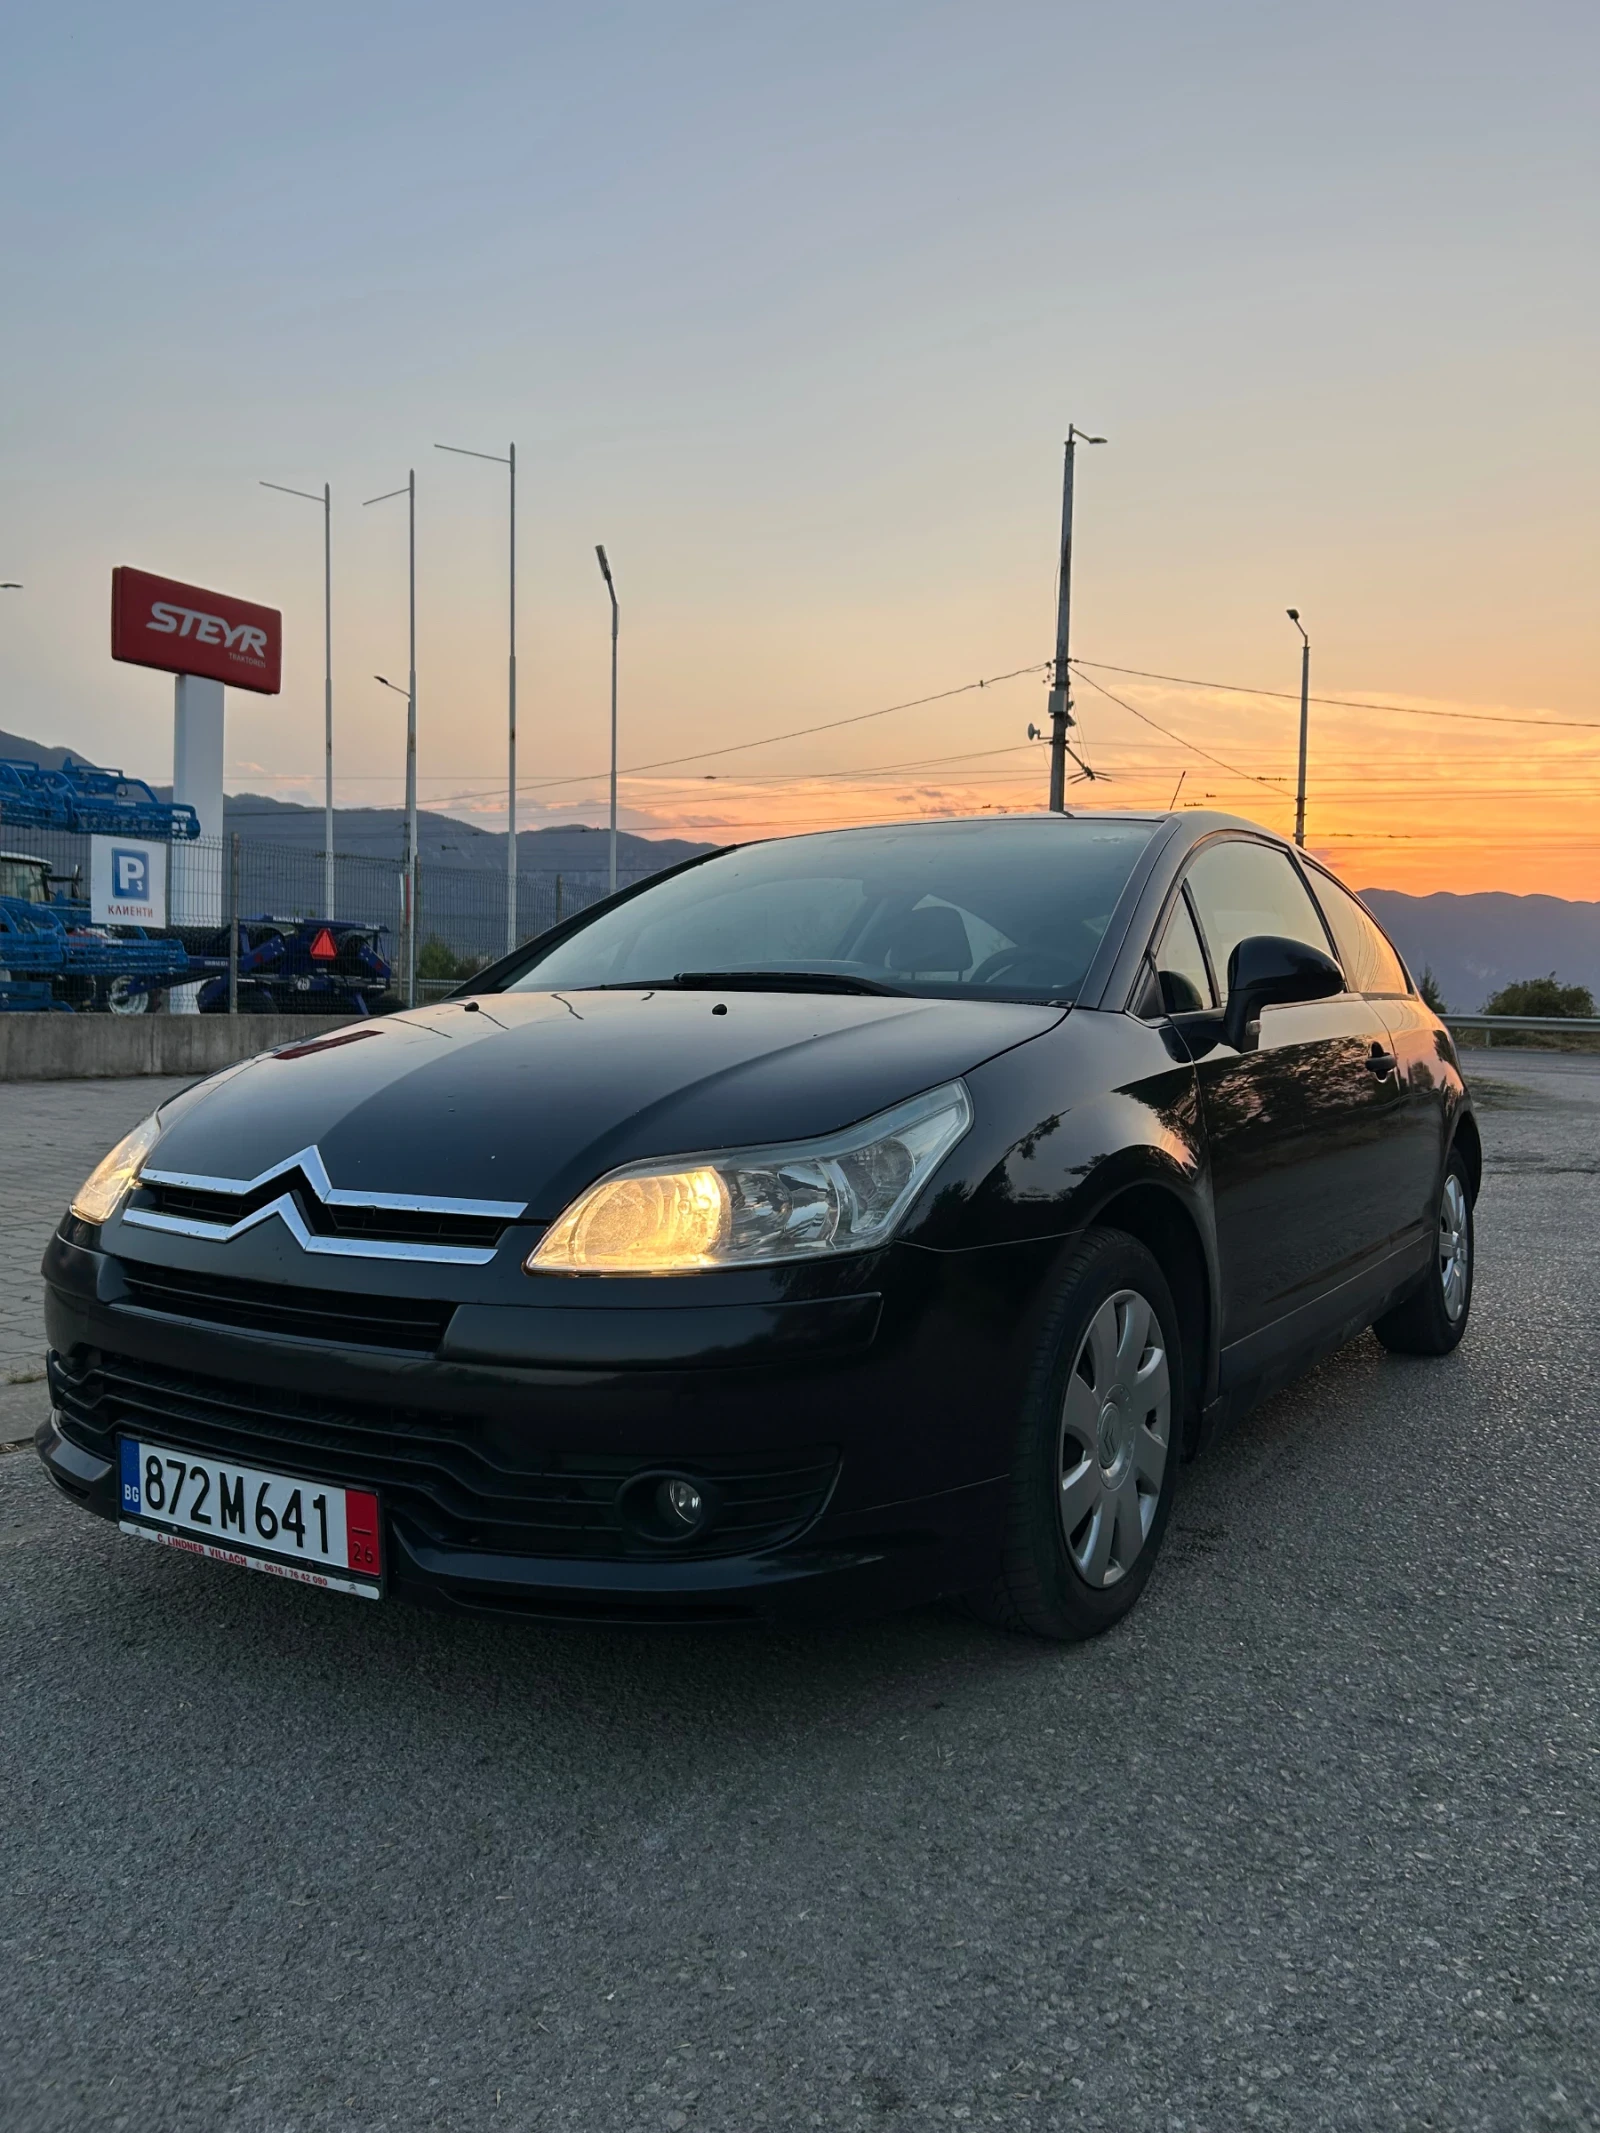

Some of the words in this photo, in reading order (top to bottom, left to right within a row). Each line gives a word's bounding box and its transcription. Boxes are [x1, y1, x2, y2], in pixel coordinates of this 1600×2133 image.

[146, 601, 268, 658] STEYR
[229, 652, 266, 669] TRAKTOREN
[107, 904, 154, 918] КЛИЕНТИ
[124, 1484, 139, 1503] BG
[157, 1533, 165, 1544] C.
[167, 1536, 204, 1555] LINDNER
[209, 1547, 247, 1566] VILLACH
[353, 1541, 374, 1564] 26
[264, 1563, 283, 1576] 0676
[289, 1570, 299, 1579] 76
[301, 1573, 311, 1583] 42
[312, 1576, 328, 1587] 090
